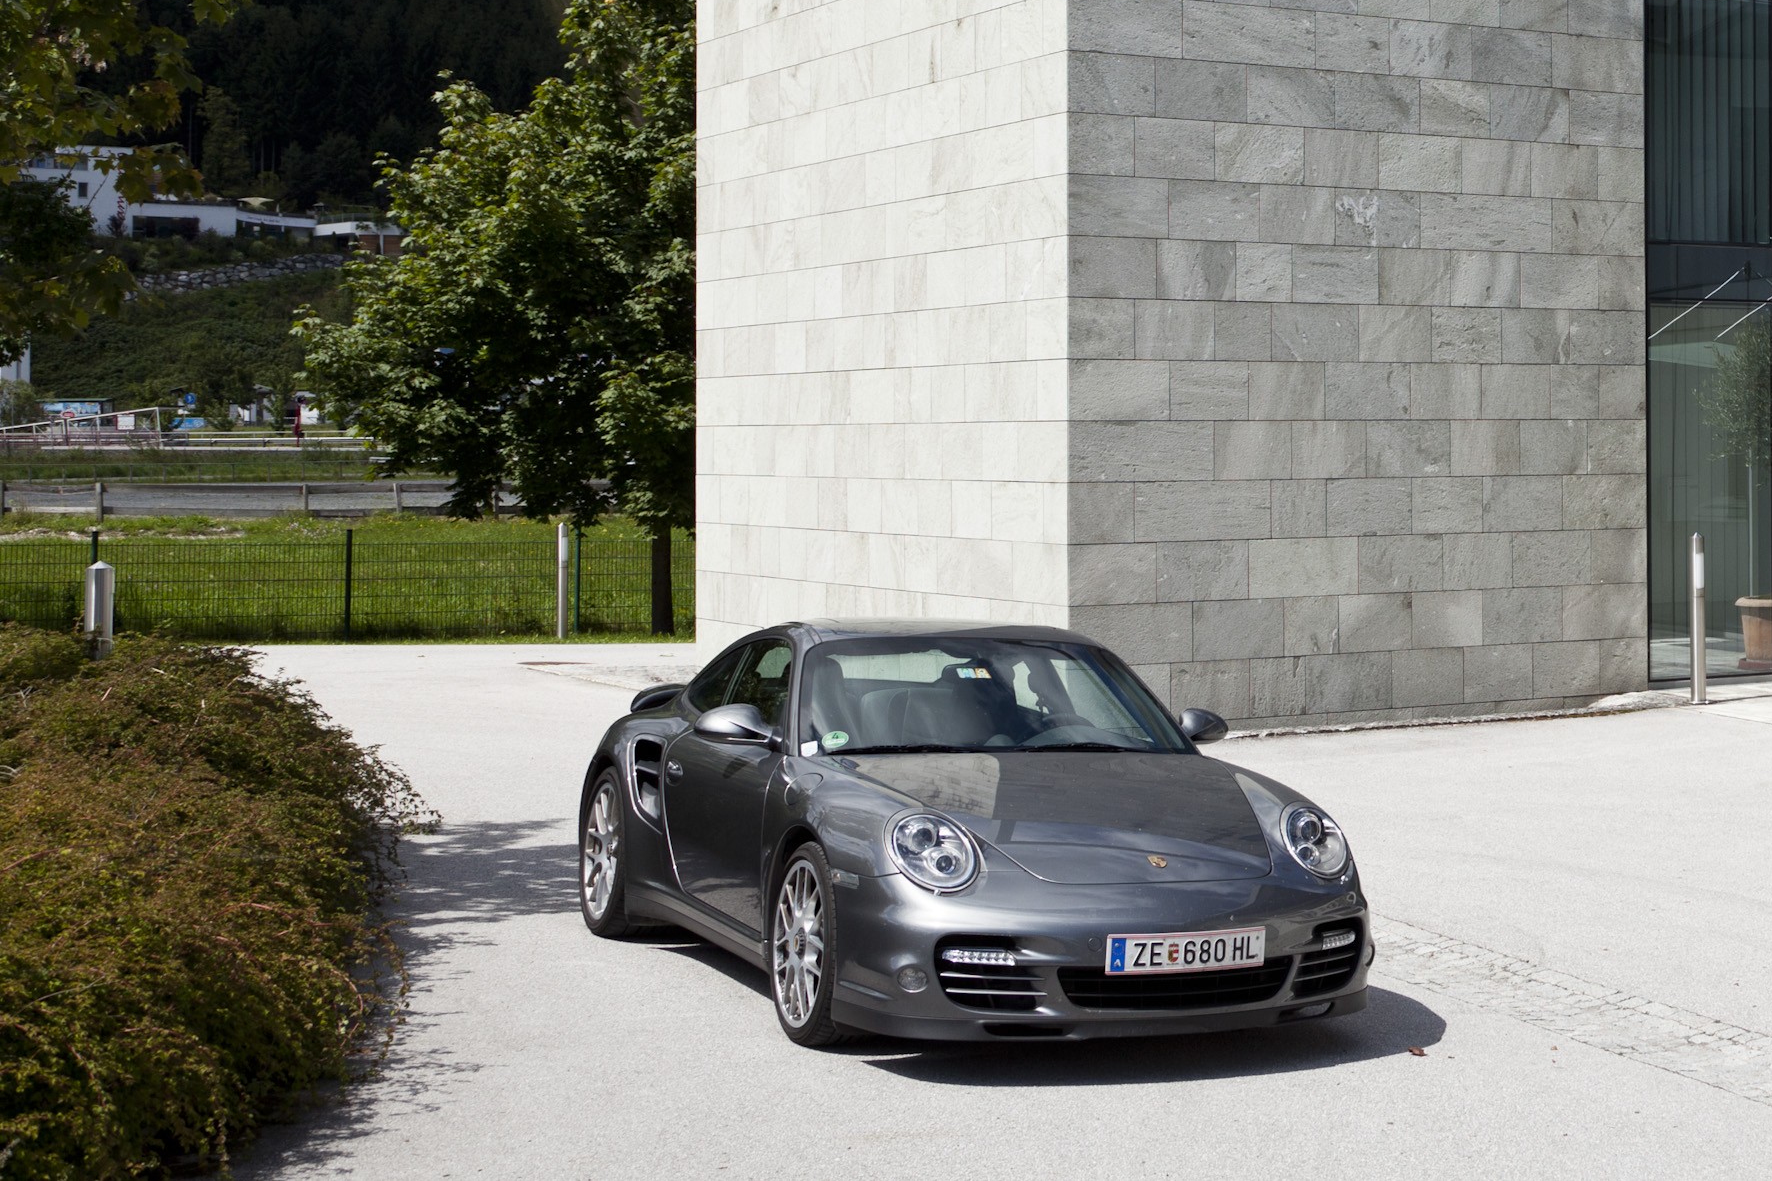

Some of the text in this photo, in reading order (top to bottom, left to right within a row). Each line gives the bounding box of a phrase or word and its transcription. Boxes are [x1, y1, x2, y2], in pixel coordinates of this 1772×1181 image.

[1132, 941, 1164, 967] ZE
[1183, 938, 1226, 965] 680
[1232, 935, 1257, 961] HL
